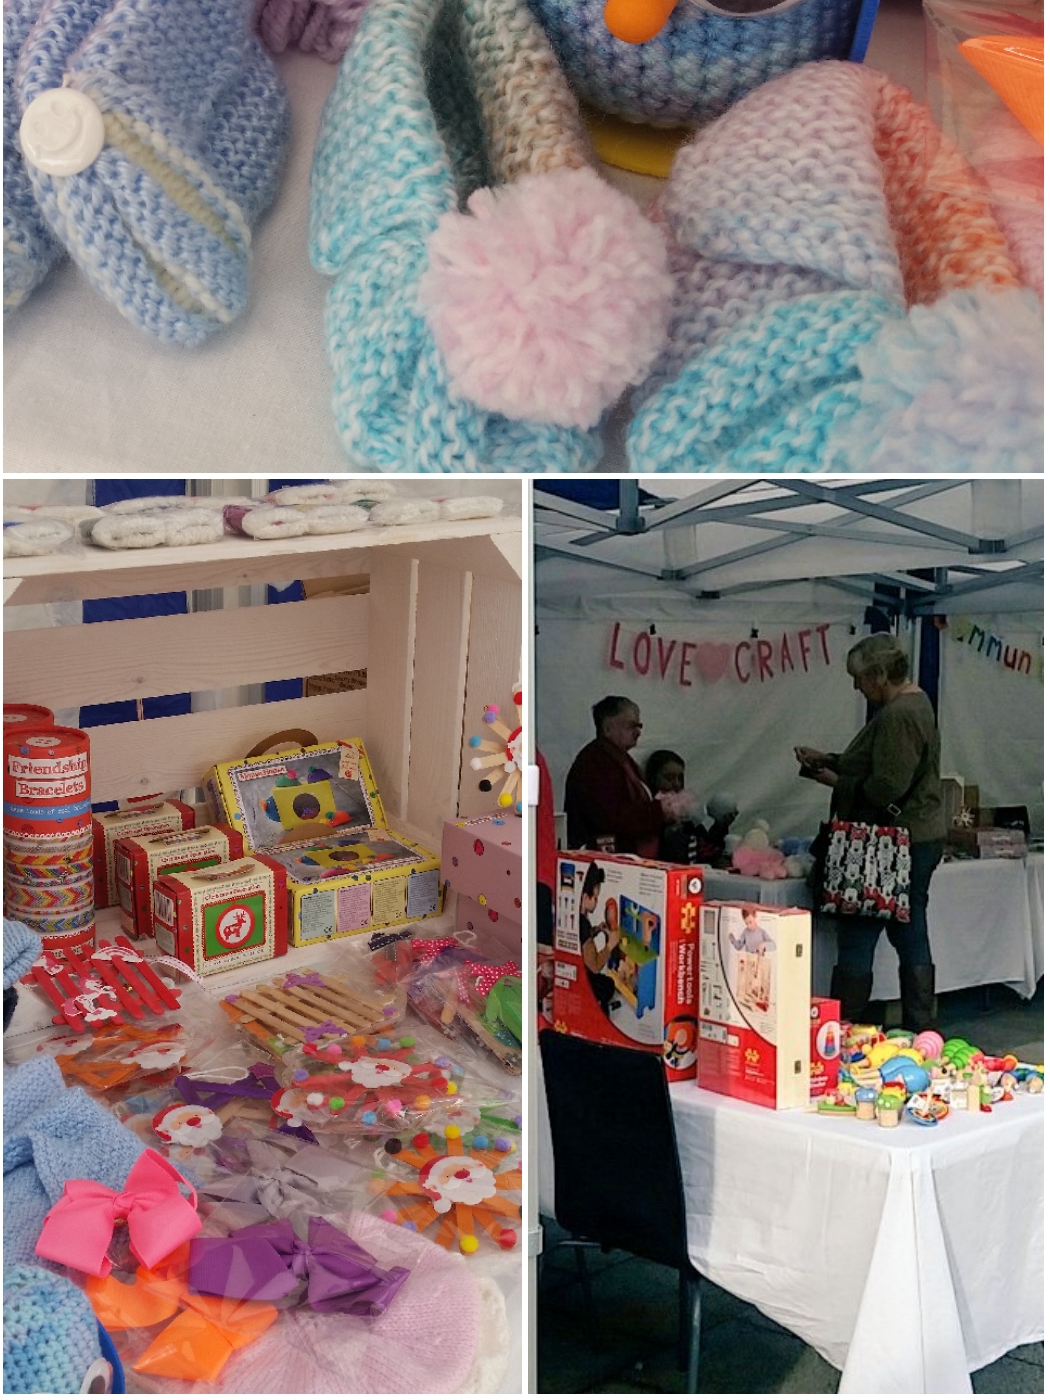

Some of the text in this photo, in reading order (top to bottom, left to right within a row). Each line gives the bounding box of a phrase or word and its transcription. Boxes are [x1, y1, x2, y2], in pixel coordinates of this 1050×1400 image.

[608, 621, 831, 688] LOVE CRAFT
[11, 758, 87, 775] Friendship
[18, 780, 84, 796] Bracelets
